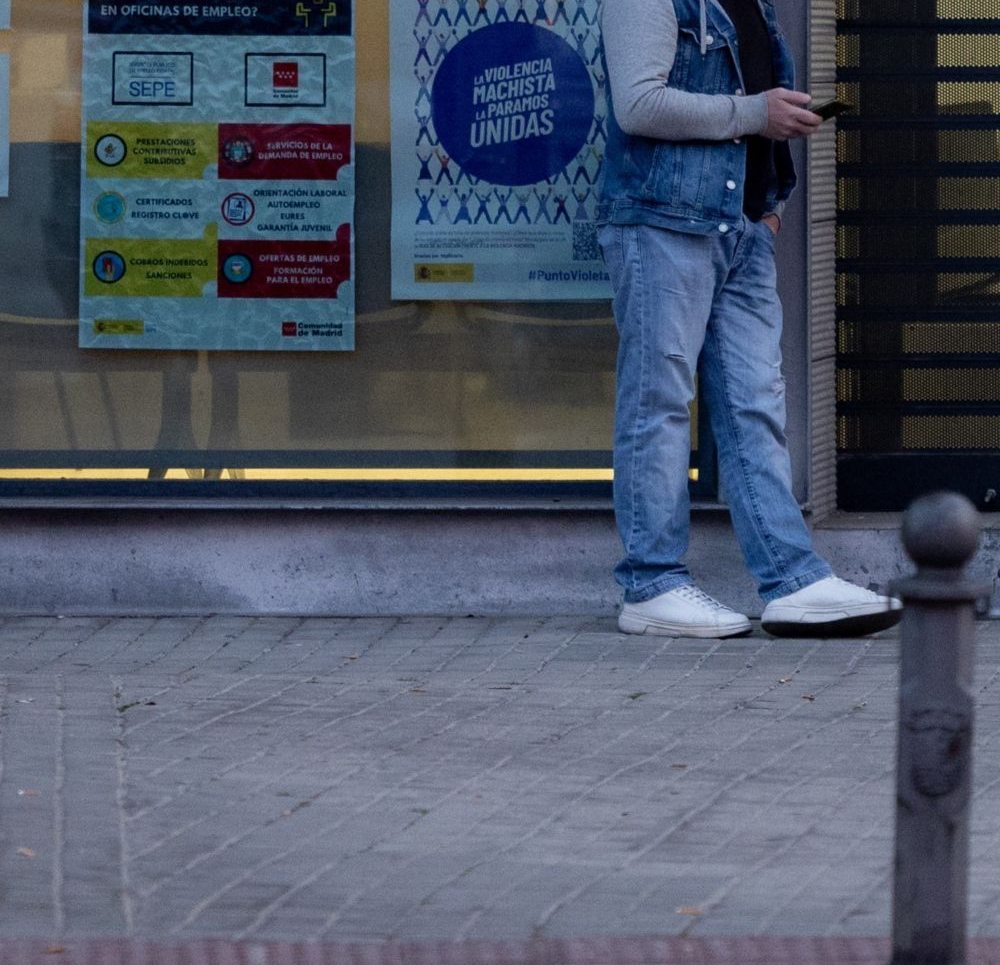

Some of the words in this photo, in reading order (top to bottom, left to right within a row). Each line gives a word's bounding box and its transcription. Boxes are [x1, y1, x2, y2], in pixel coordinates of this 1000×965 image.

[100, 5, 117, 16] EN
[121, 5, 181, 16] OFICINAS
[183, 6, 199, 16] DE
[202, 6, 258, 17] EMPLEO?
[473, 75, 484, 85] LA
[484, 57, 553, 82] VIOLENCIA
[128, 81, 175, 98] SEPE
[472, 74, 556, 105] MACHISTA
[475, 110, 487, 121] LA
[487, 94, 549, 117] PARAMOS
[470, 109, 554, 148] UNIDAS
[136, 138, 196, 147] PRESTACIONES
[310, 142, 320, 150] DE
[322, 142, 333, 150] LA
[132, 147, 197, 156] CONTRIBUTIVAS
[258, 151, 298, 160] DEMANDA
[311, 152, 343, 161] EMPLEO
[253, 188, 308, 197] ORIENTACIÓN
[135, 198, 193, 206] CERTIFICADOS
[267, 201, 320, 209] AUTOEMPLEO
[131, 211, 171, 220] REGISTRO
[280, 212, 305, 220] EURES
[257, 222, 299, 231] GARANTÍA
[301, 224, 332, 232] JUVENIL
[259, 254, 295, 263] OFERTAS
[296, 254, 307, 262] DE
[308, 254, 340, 263] EMPLEO
[273, 265, 323, 275] FORMACIÓN
[146, 271, 193, 280] SANCIONES
[266, 276, 289, 284] PARA
[290, 276, 300, 284] EL
[301, 276, 333, 284] EMPLEO
[528, 269, 610, 282] #PuntoVioleta
[298, 329, 309, 337] de
[312, 329, 343, 337] Madrid
